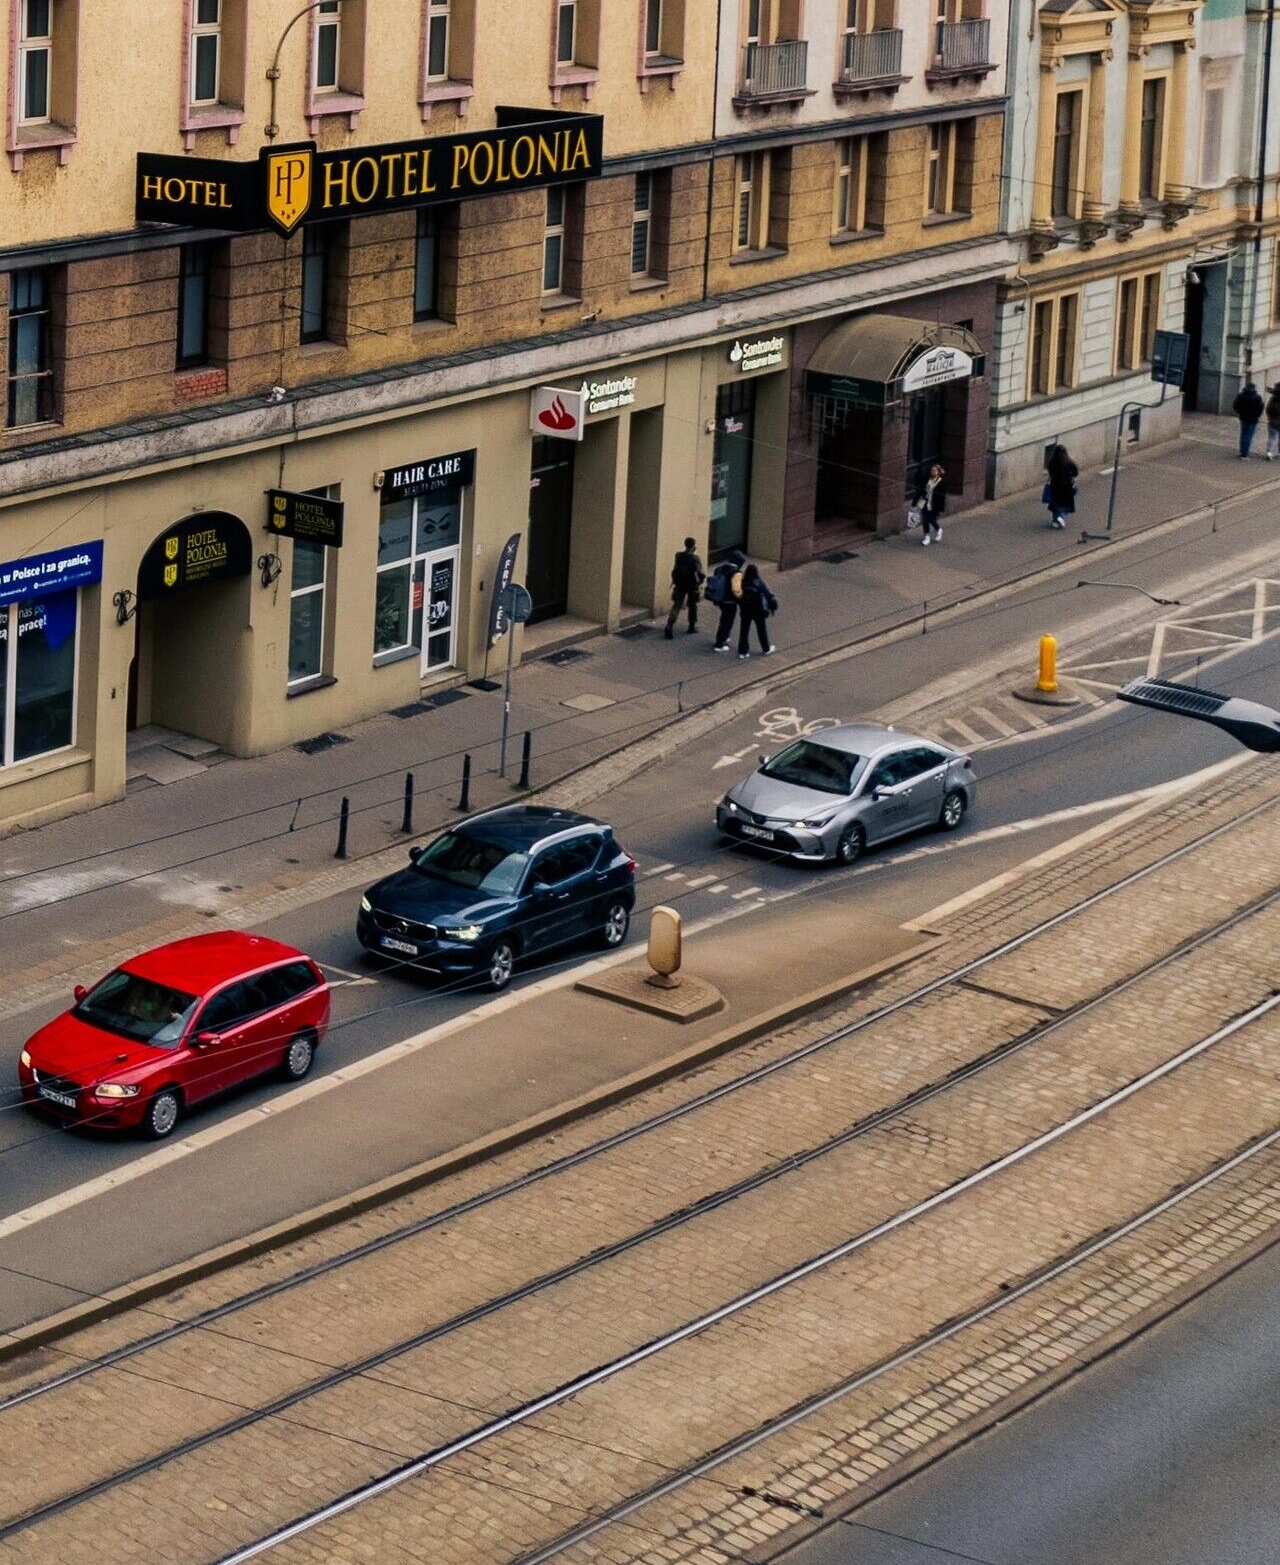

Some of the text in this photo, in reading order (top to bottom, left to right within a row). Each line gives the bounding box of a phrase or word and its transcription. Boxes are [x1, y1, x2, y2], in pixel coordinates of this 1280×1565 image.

[322, 128, 592, 209] HOTEL POLONIA
[142, 174, 233, 208] HOTEL
[742, 336, 784, 358] Santander
[590, 376, 637, 399] Santander
[392, 457, 461, 488] HAIR CARE
[295, 501, 325, 516] HOTEL
[187, 529, 218, 548] HOTEL
[186, 542, 228, 564] POLONIA
[2, 574, 11, 584] w
[12, 567, 40, 581] Polsce
[41, 563, 45, 574] i
[46, 562, 57, 572] za
[18, 607, 33, 619] nas
[18, 614, 47, 637] pracę!
